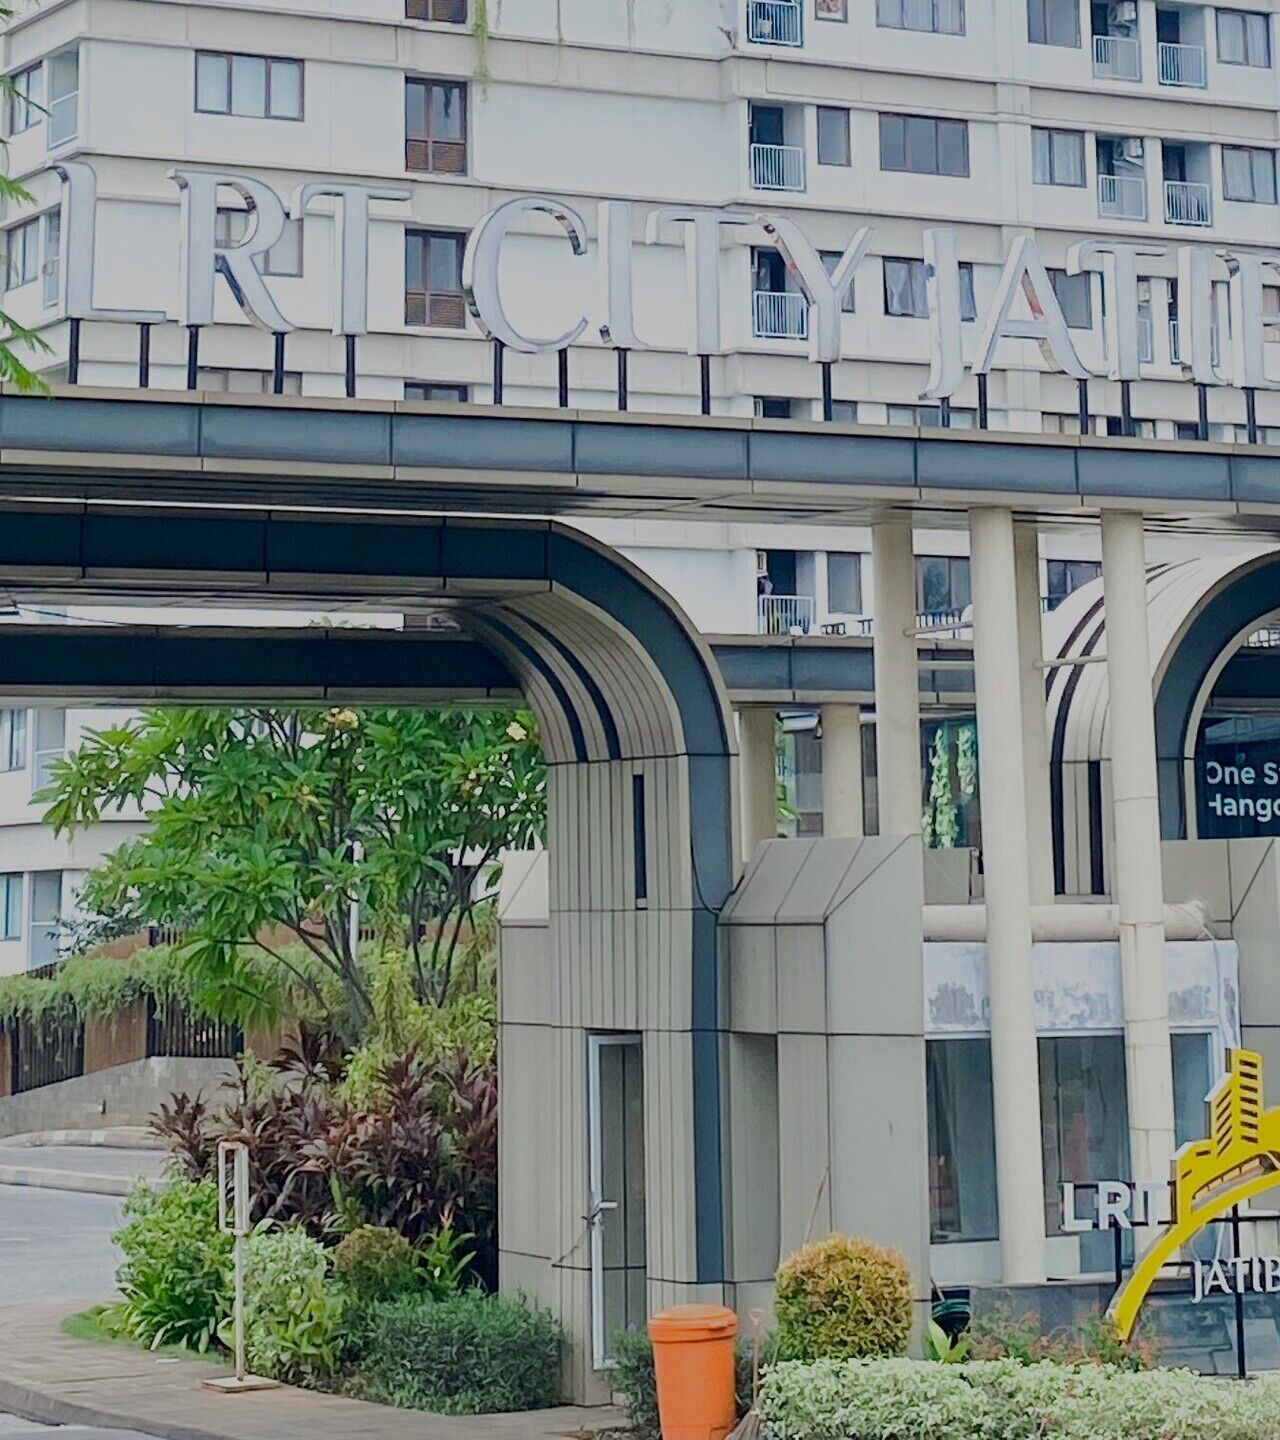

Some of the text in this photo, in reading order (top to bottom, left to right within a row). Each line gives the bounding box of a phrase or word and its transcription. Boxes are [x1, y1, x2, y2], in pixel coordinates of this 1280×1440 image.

[50, 159, 413, 339] LRT
[463, 195, 878, 363] CITY
[1206, 761, 1256, 785] One
[1060, 1180, 1172, 1232] LRT
